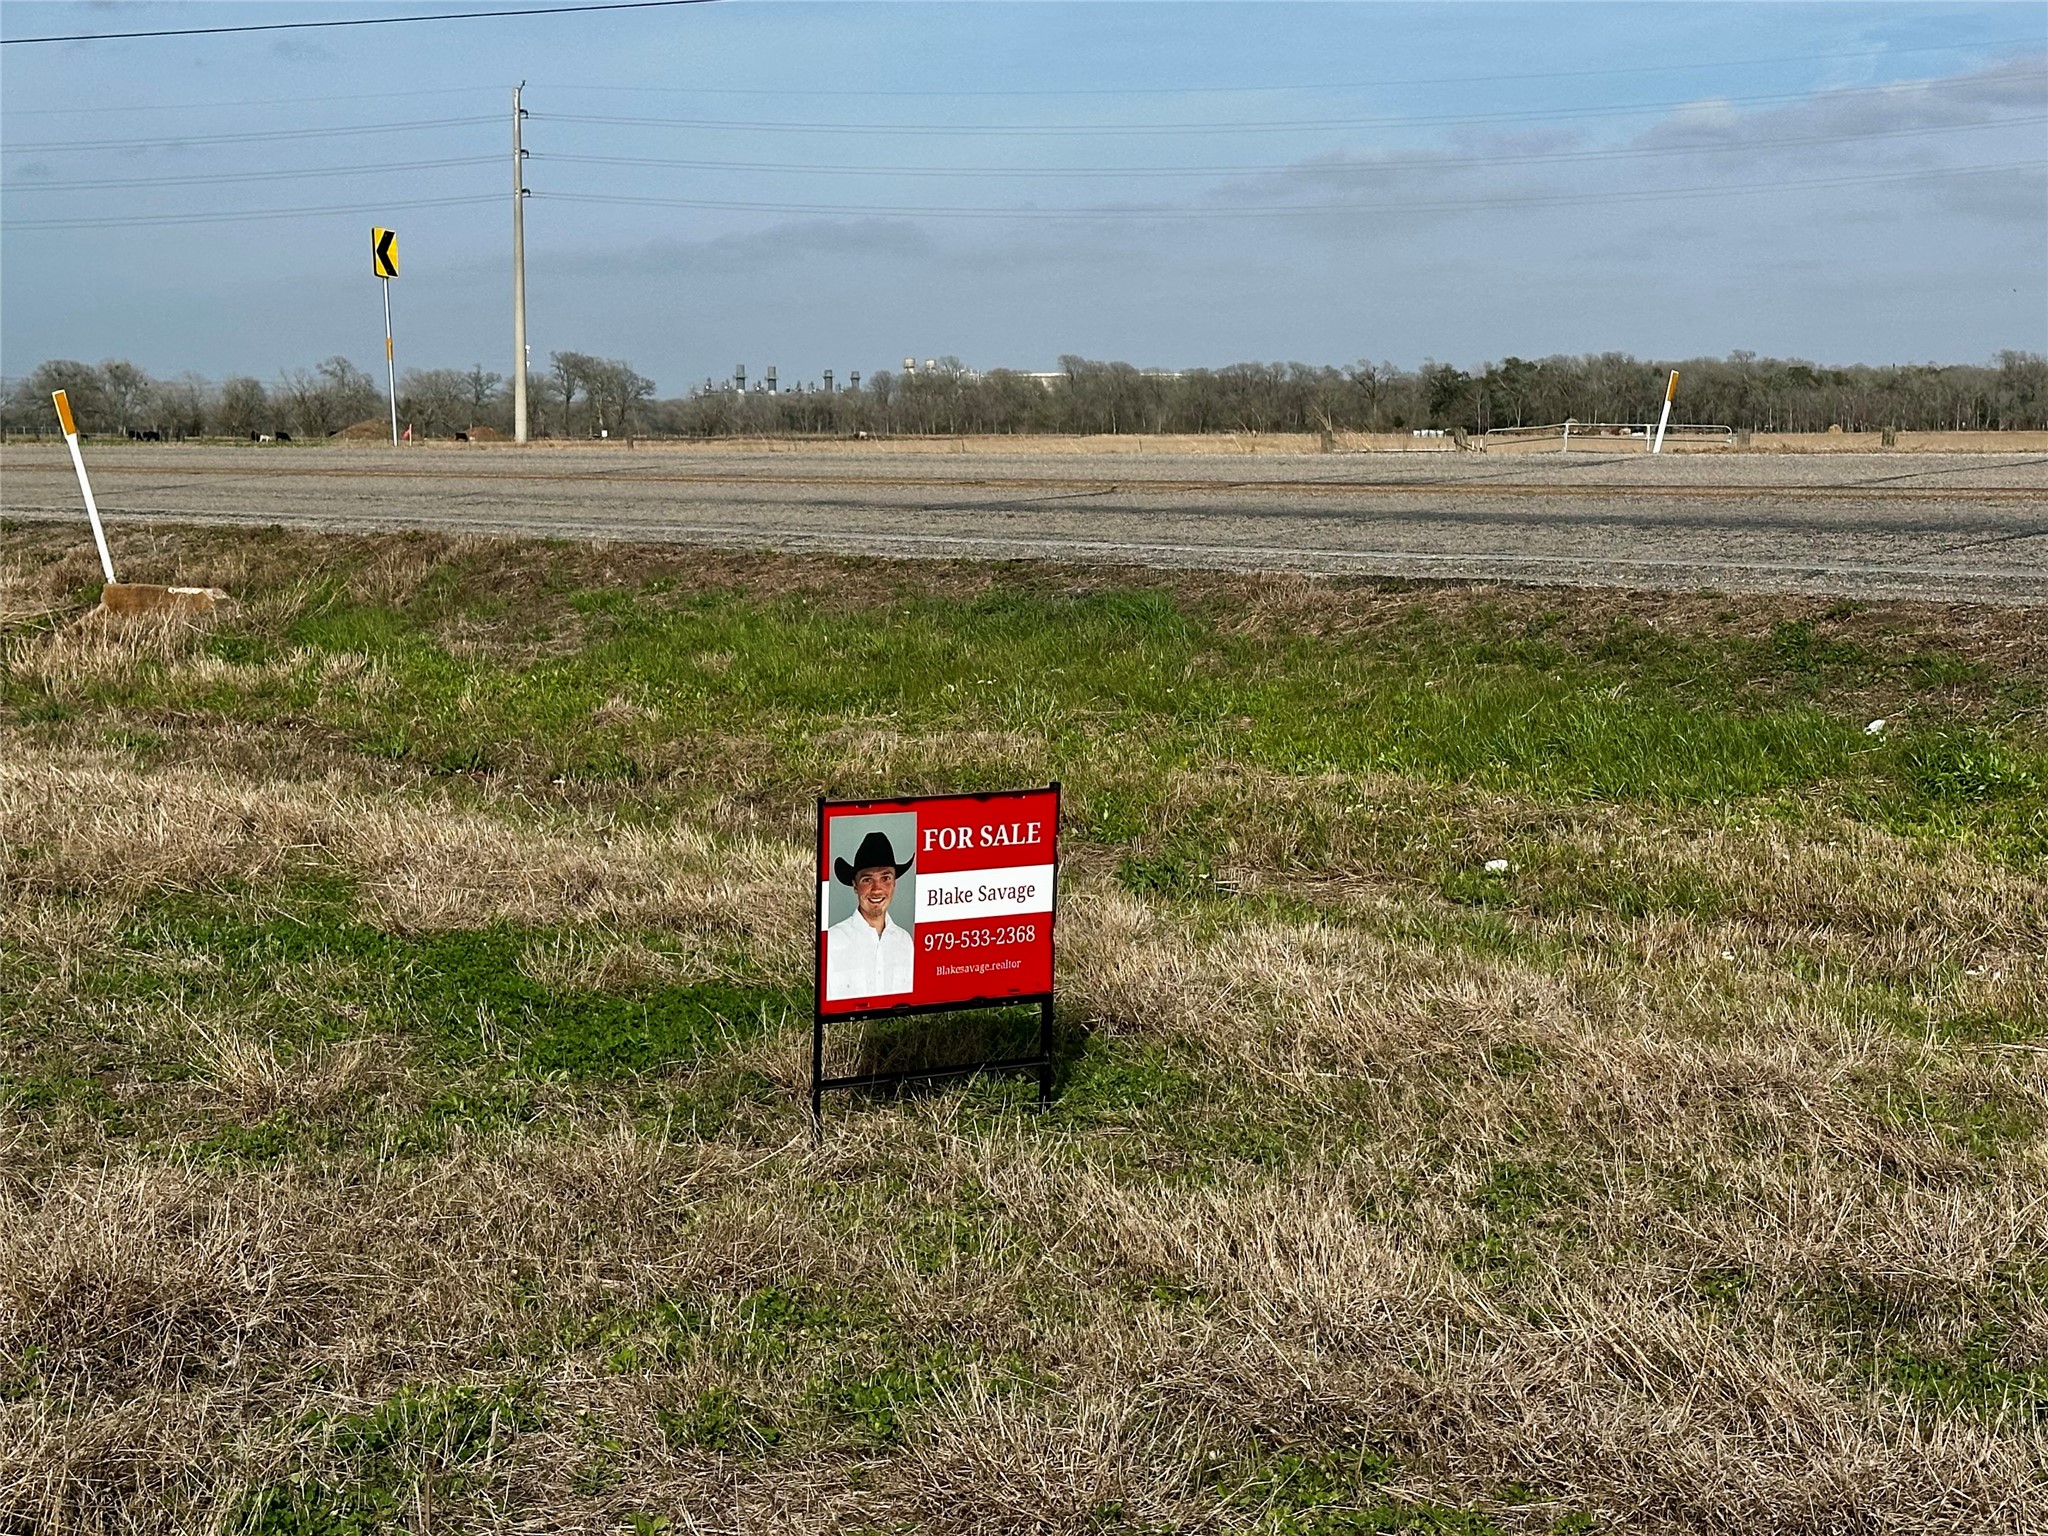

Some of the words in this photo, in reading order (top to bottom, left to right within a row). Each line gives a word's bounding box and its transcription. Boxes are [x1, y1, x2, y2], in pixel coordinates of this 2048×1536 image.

[923, 827, 974, 851] FOR
[980, 822, 1041, 847] SALE
[927, 888, 973, 906] Blake
[978, 884, 1036, 904] Savage
[924, 924, 1036, 951] 979-533-2368
